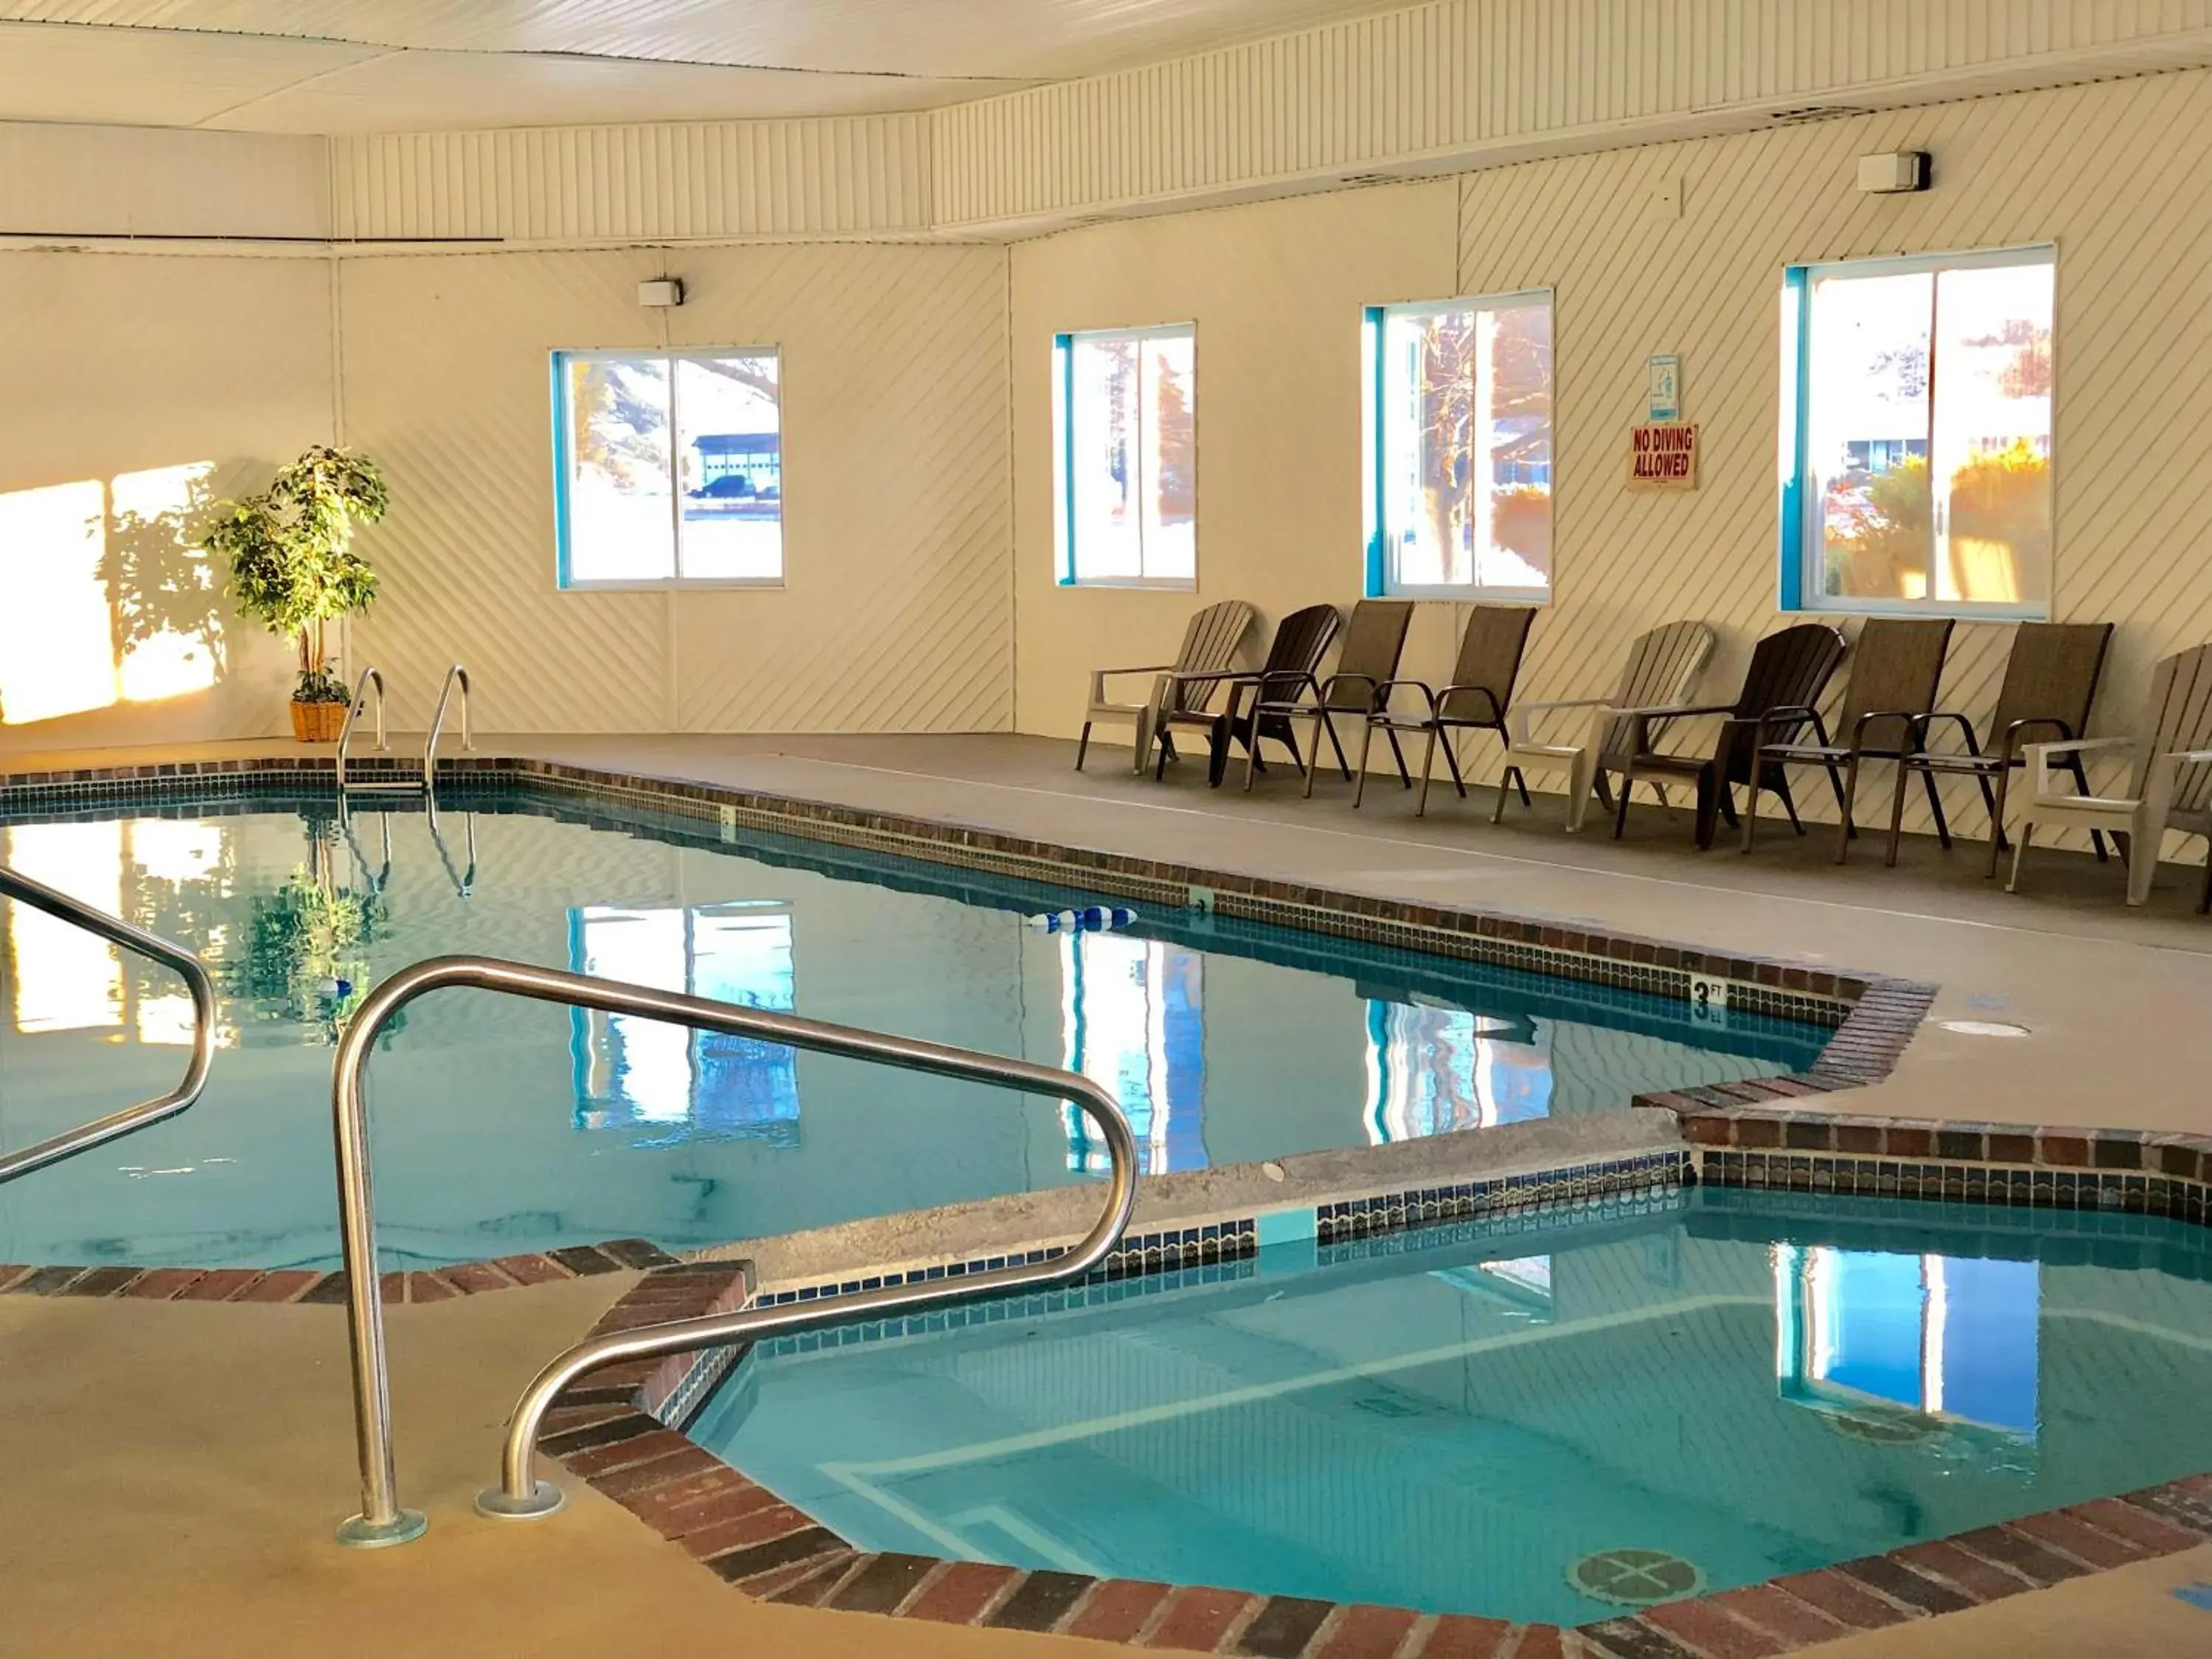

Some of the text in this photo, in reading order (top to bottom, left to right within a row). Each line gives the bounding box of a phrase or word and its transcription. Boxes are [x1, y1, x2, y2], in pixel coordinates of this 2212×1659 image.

[1633, 427, 1692, 452] NO DIVING
[1633, 453, 1689, 477] ALLOWED
[1694, 981, 1708, 1004] 3
